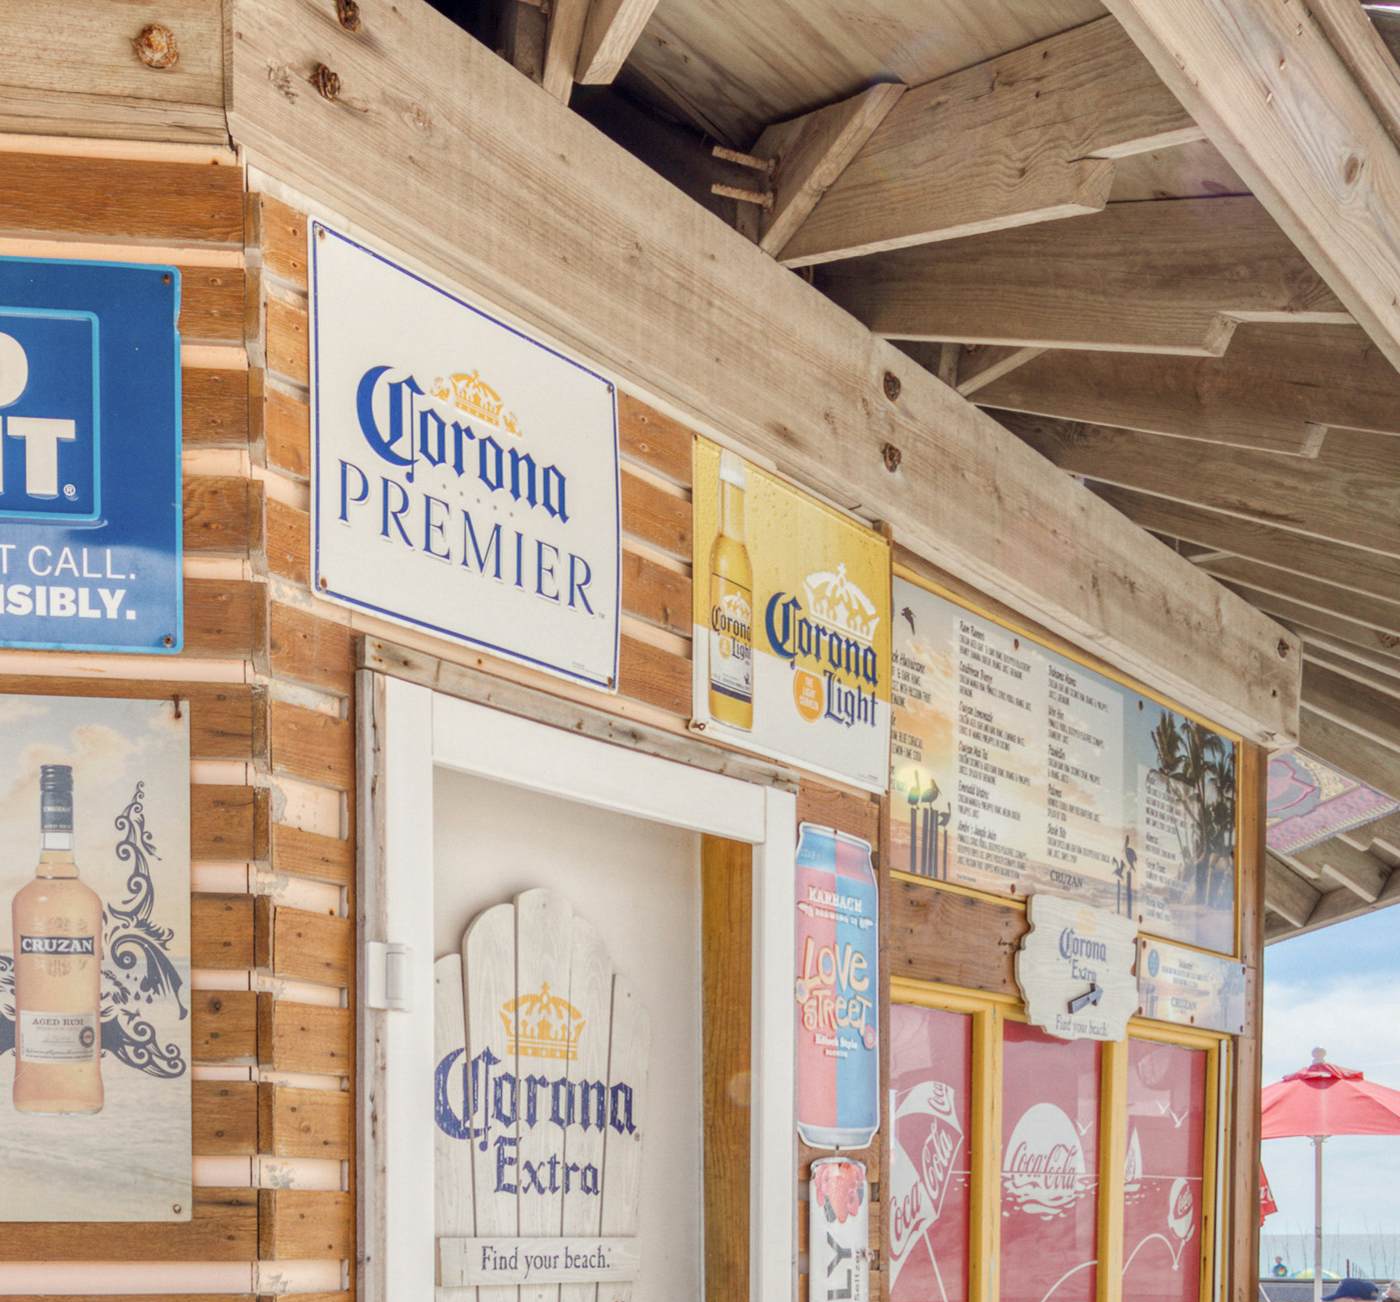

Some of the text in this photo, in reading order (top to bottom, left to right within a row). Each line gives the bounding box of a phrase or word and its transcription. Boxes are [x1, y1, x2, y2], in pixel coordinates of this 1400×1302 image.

[0, 416, 75, 496] T
[355, 364, 571, 525] Corona
[28, 545, 136, 580] CALL.
[337, 457, 597, 617] PREMIER
[0, 584, 137, 621] SIBLY.
[764, 591, 879, 686] Corona
[823, 669, 879, 729] Light
[1049, 869, 1084, 888] CRUZAN
[22, 938, 93, 953] CRUZAN
[1059, 927, 1107, 963] Corona
[434, 1045, 637, 1152] Corona
[493, 1135, 602, 1196] Extra
[922, 1116, 955, 1200] Cola
[481, 1246, 519, 1272] Find
[523, 1250, 560, 1279] your
